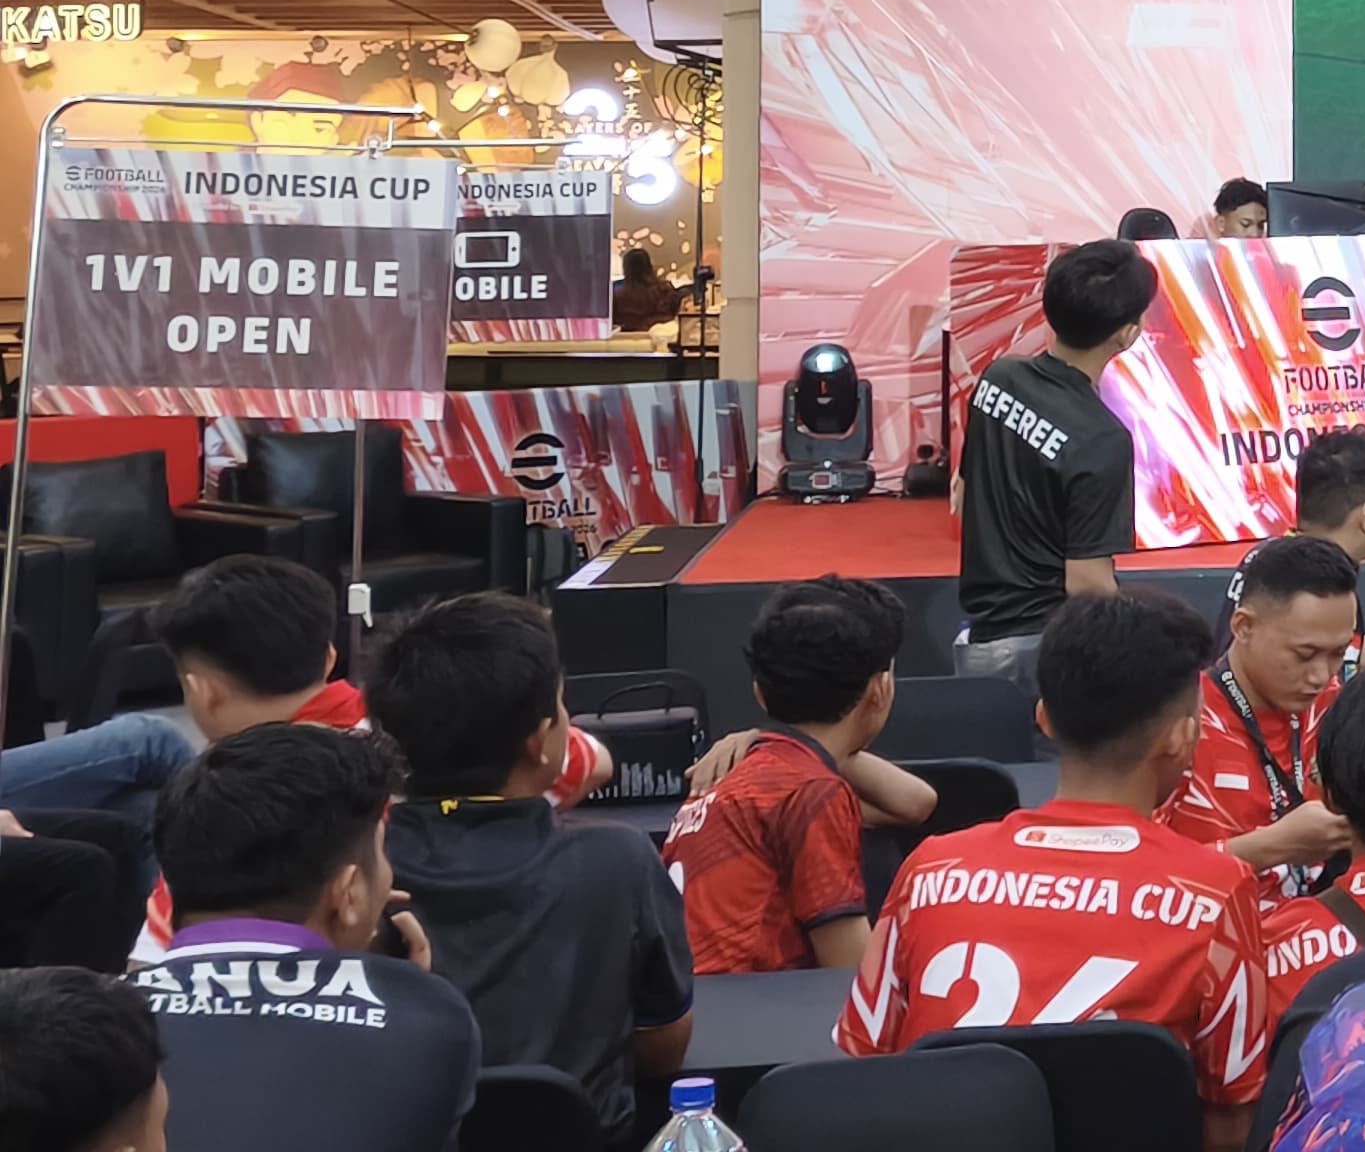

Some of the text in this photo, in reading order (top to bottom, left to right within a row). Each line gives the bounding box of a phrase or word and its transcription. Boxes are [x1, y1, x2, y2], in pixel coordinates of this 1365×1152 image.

[85, 167, 431, 201] FOOTBALL INDONESIA CUP
[457, 183, 553, 199] NDONESIA
[560, 182, 597, 197] CUP
[86, 253, 400, 300] 1V1 MOBILE
[455, 275, 548, 301] OBILE
[167, 314, 312, 356] OPEN
[972, 379, 1069, 460] REFEREE
[527, 497, 597, 521] TBALL
[909, 868, 1224, 931] INDONESIA CUP
[149, 993, 387, 1028] TBALL MOBILE
